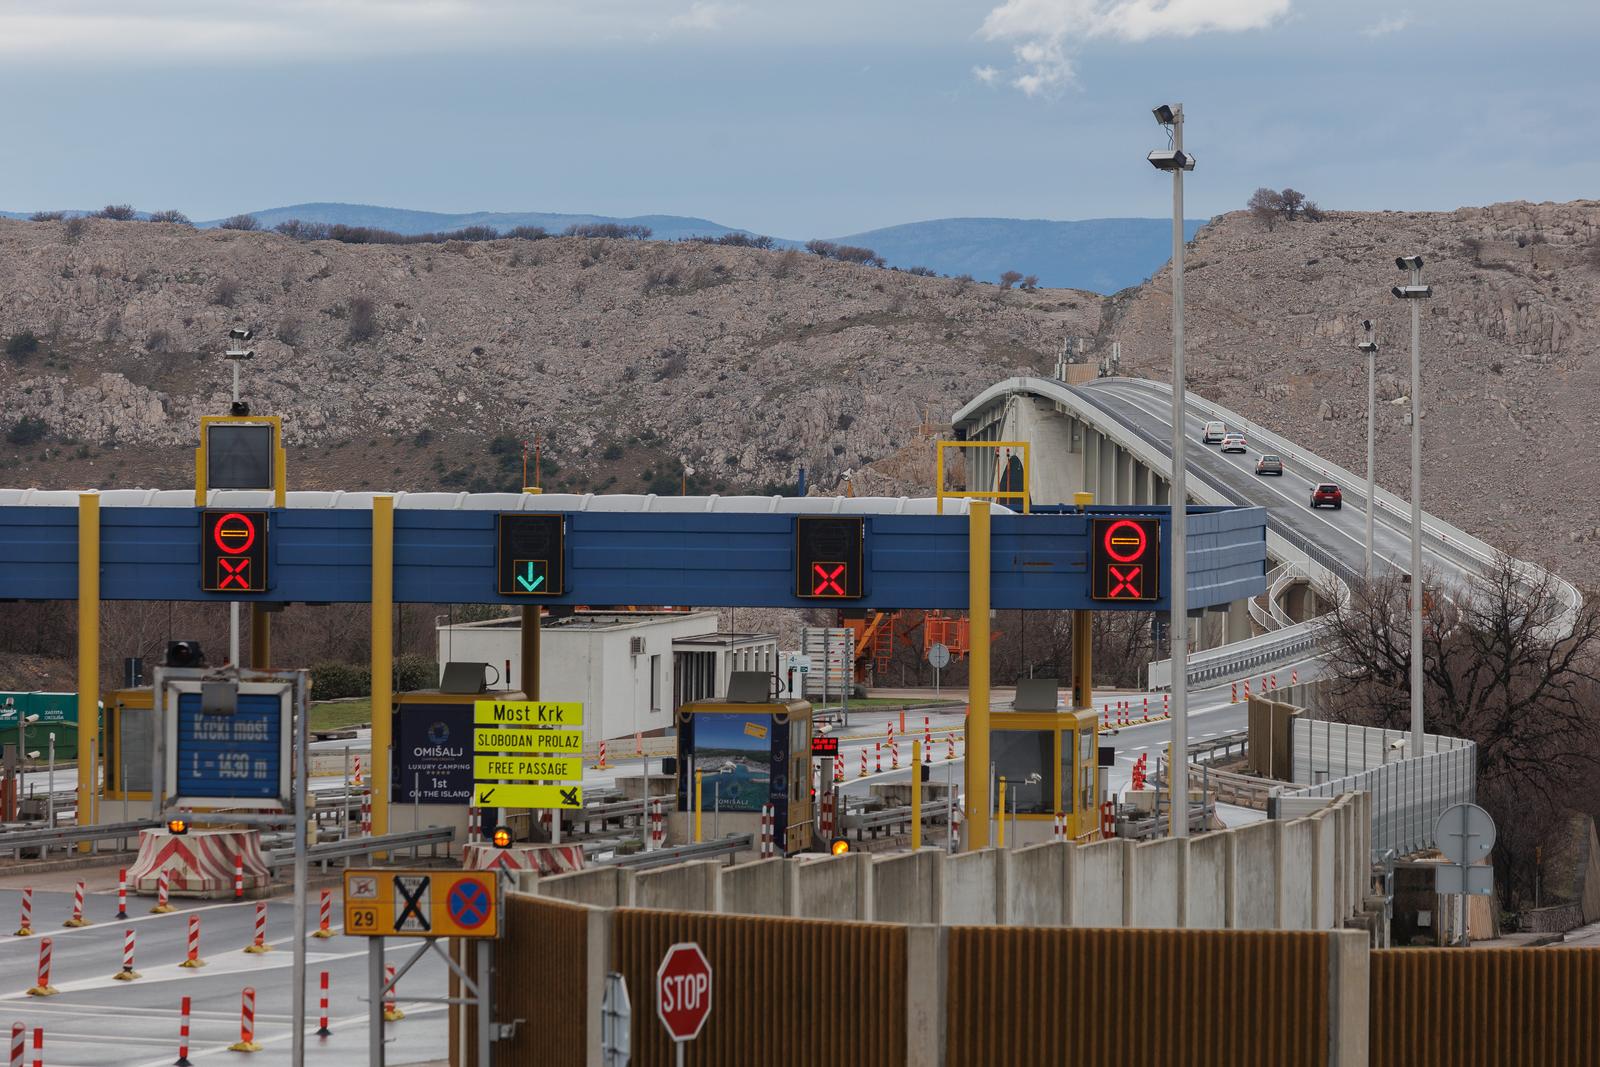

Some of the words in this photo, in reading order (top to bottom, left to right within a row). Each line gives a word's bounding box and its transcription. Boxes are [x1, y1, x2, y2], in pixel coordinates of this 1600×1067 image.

[494, 704, 530, 721] Most
[538, 705, 563, 721] Krk
[234, 715, 269, 740] most
[478, 733, 533, 748] SLOBODAN
[538, 735, 579, 748] PROLAZ
[413, 745, 463, 757] OMIŠALJ
[193, 752, 202, 777] L
[218, 753, 249, 778] 1430
[254, 760, 267, 778] m
[488, 761, 514, 775] FREE
[518, 762, 568, 776] PASSAGE
[431, 777, 448, 789] 1st
[423, 790, 439, 798] THE
[440, 790, 471, 798] ISLAND
[353, 911, 374, 927] 29
[663, 973, 707, 1012] STOP
